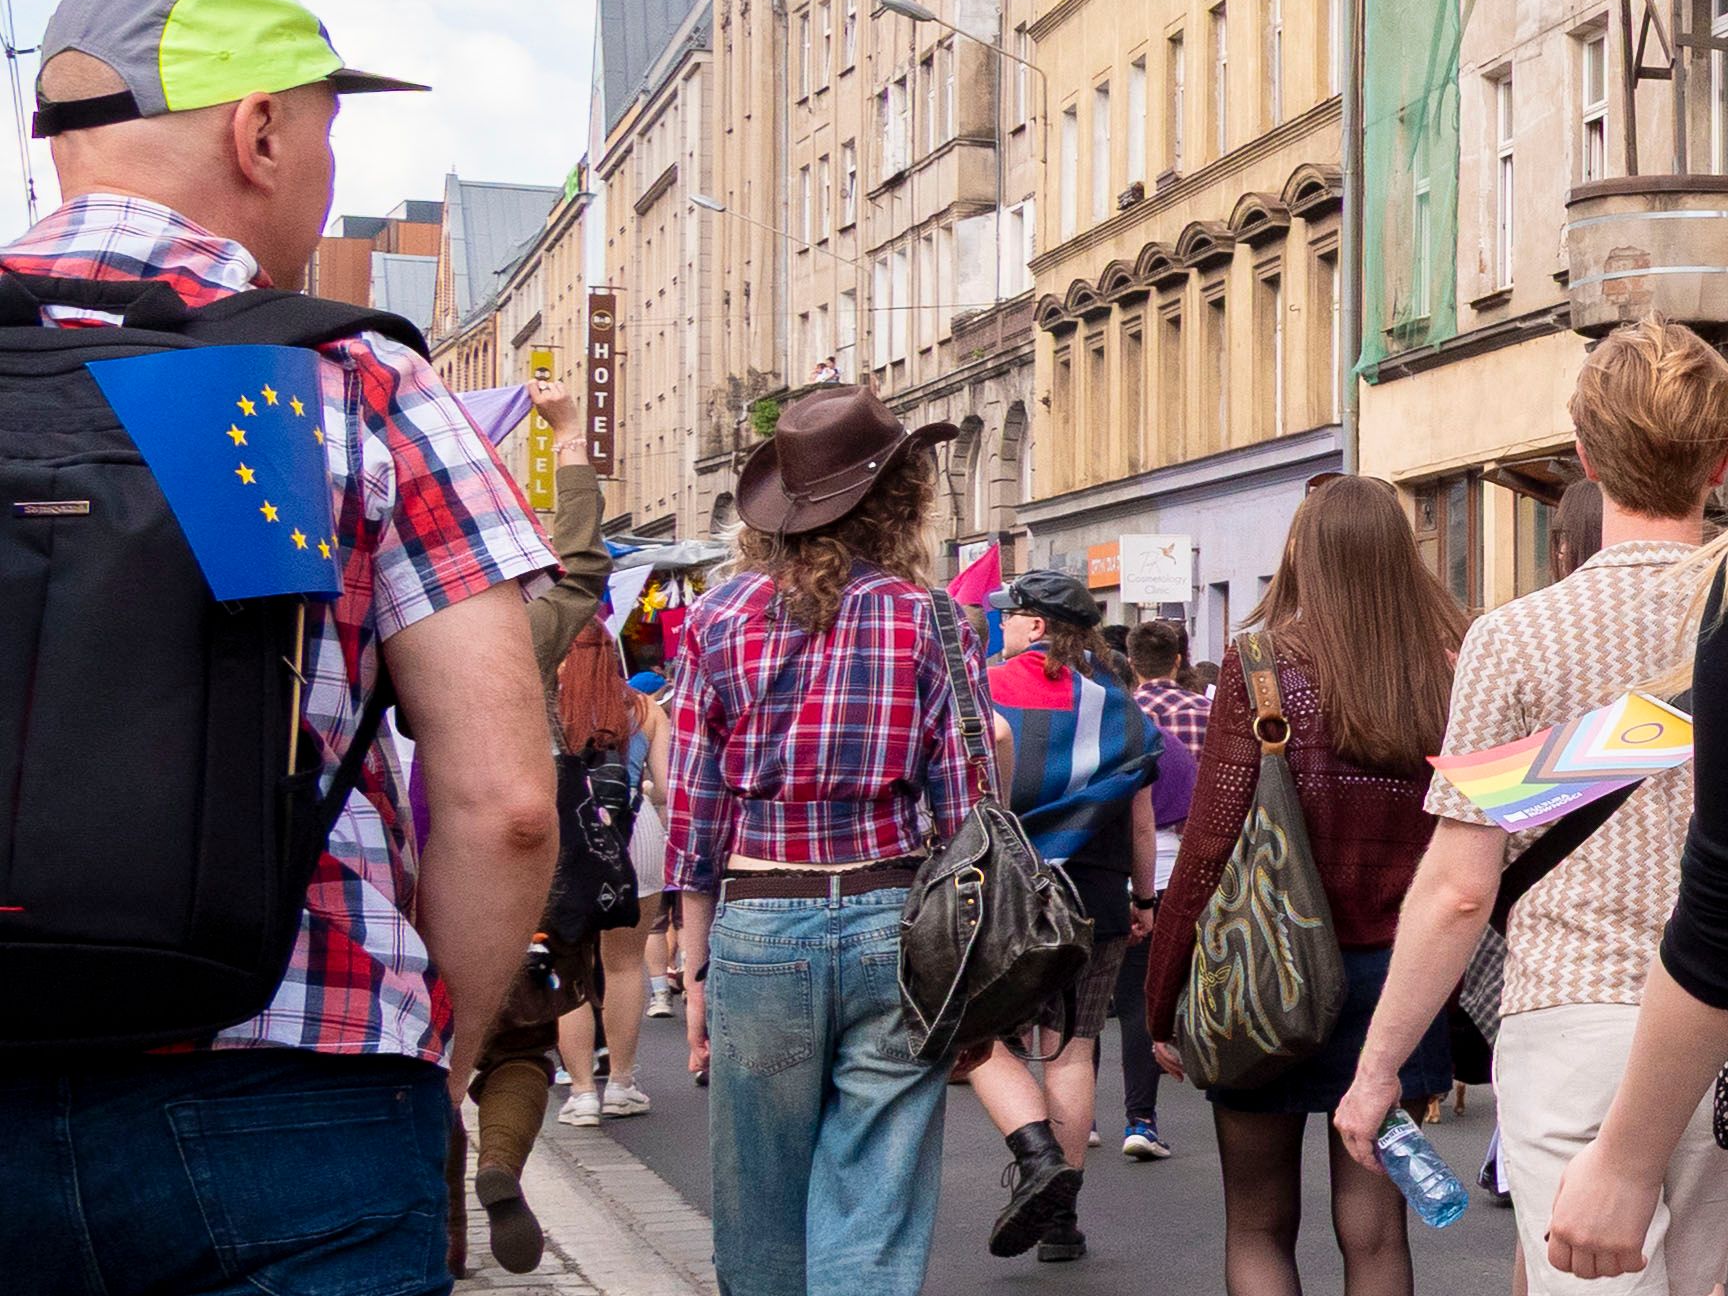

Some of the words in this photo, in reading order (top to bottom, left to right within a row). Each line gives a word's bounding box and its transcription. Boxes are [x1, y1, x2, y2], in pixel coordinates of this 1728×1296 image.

[592, 342, 609, 458] HOTEL
[535, 415, 548, 494] OTEL
[1126, 573, 1188, 585] Cosmetology
